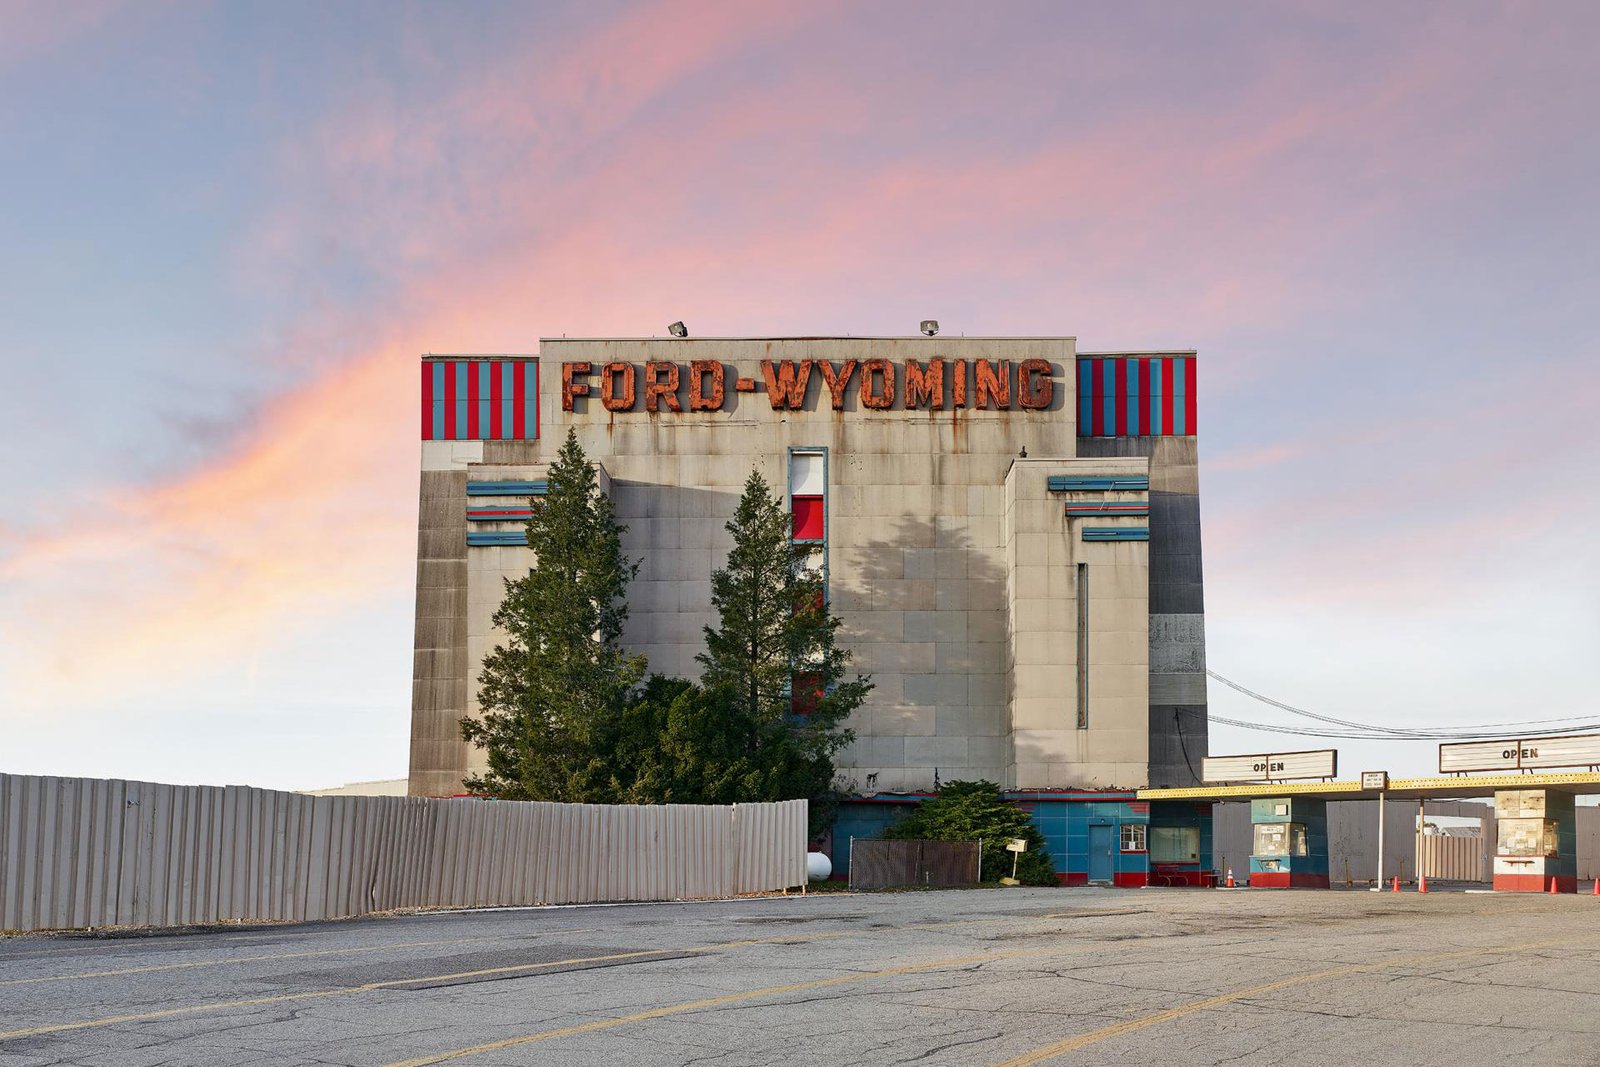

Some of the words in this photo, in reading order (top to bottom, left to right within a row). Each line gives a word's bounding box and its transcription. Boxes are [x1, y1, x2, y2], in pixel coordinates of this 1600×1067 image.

[562, 358, 1053, 412] FORD-WYOMING
[1502, 748, 1539, 759] OPEN
[1253, 762, 1284, 772] OPEN
